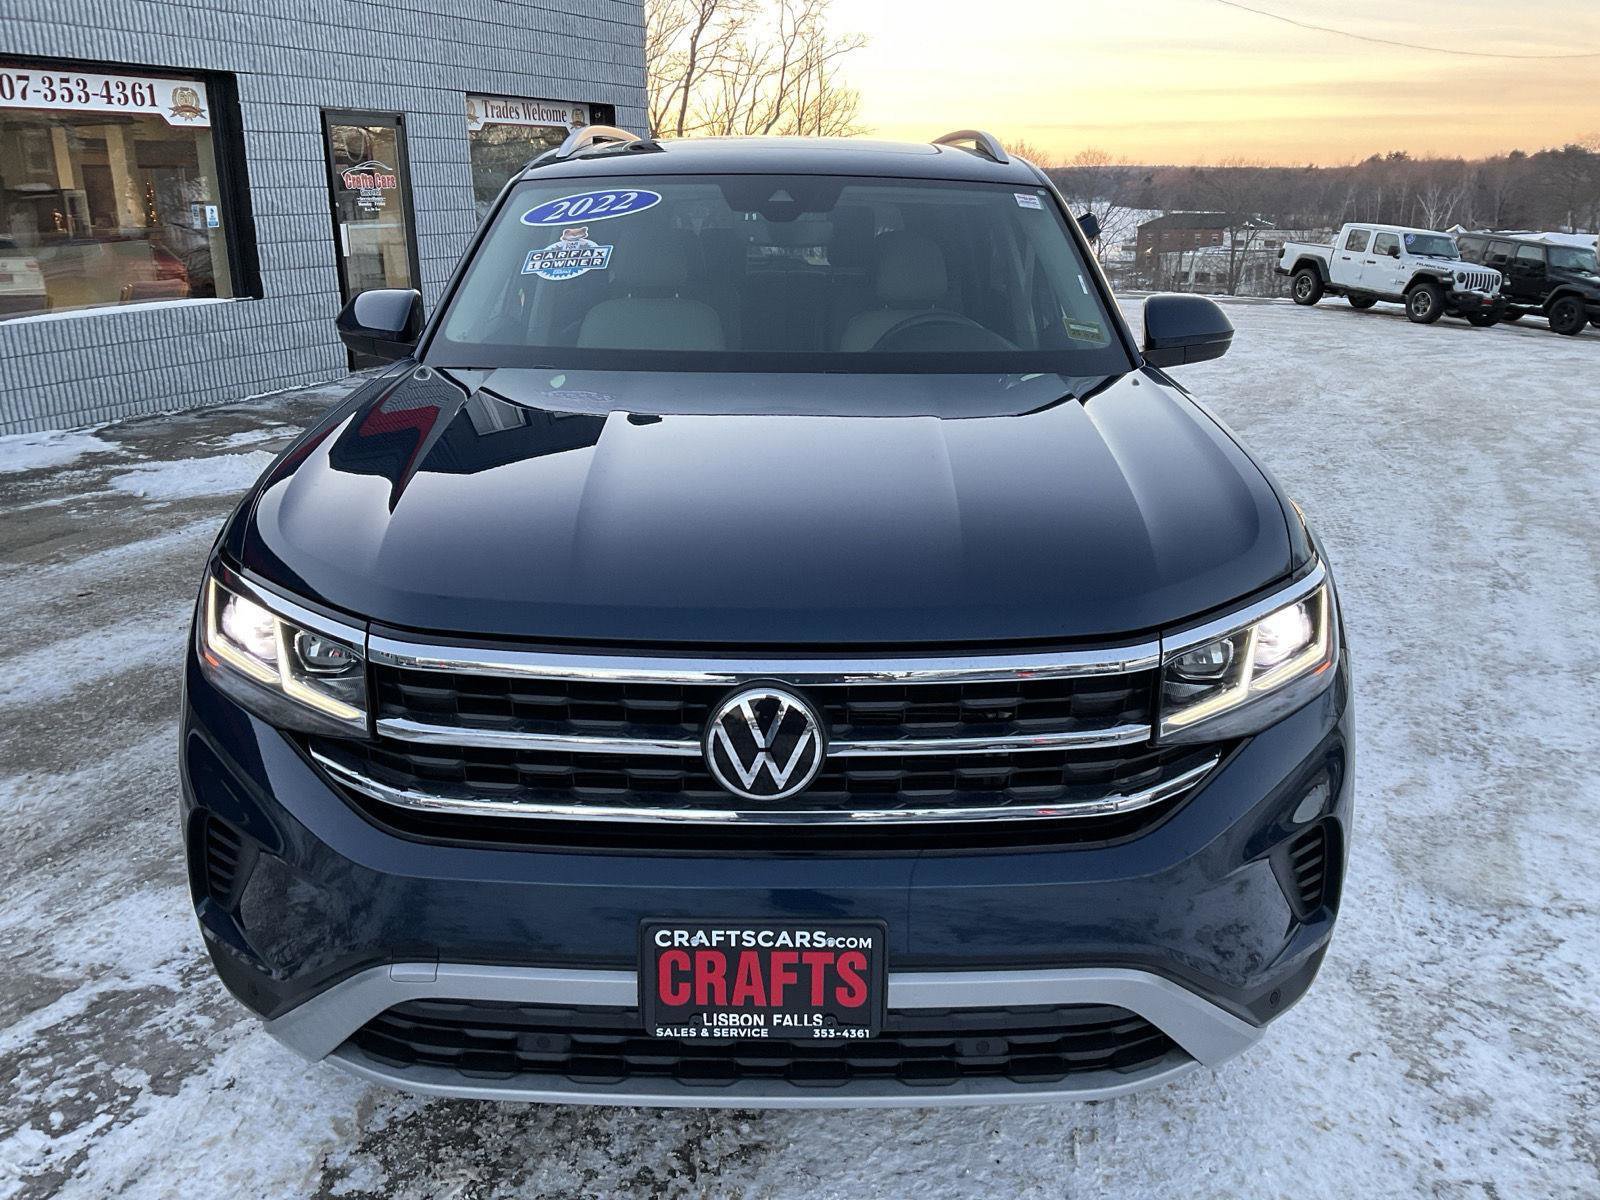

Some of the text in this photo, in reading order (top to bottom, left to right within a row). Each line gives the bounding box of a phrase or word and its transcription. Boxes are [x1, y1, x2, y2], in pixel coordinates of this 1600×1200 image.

[481, 100, 567, 123] Trades Welcome
[344, 172, 397, 190] Crafts Cars
[542, 192, 639, 222] 2022
[532, 249, 606, 260] CARFAX
[541, 258, 603, 269] OWNER
[658, 949, 869, 1008] CRAFTS
[702, 1012, 823, 1027] LISBON FALLS
[656, 1027, 769, 1038] SALES & SERVICE
[813, 1028, 870, 1039] 353-4361
